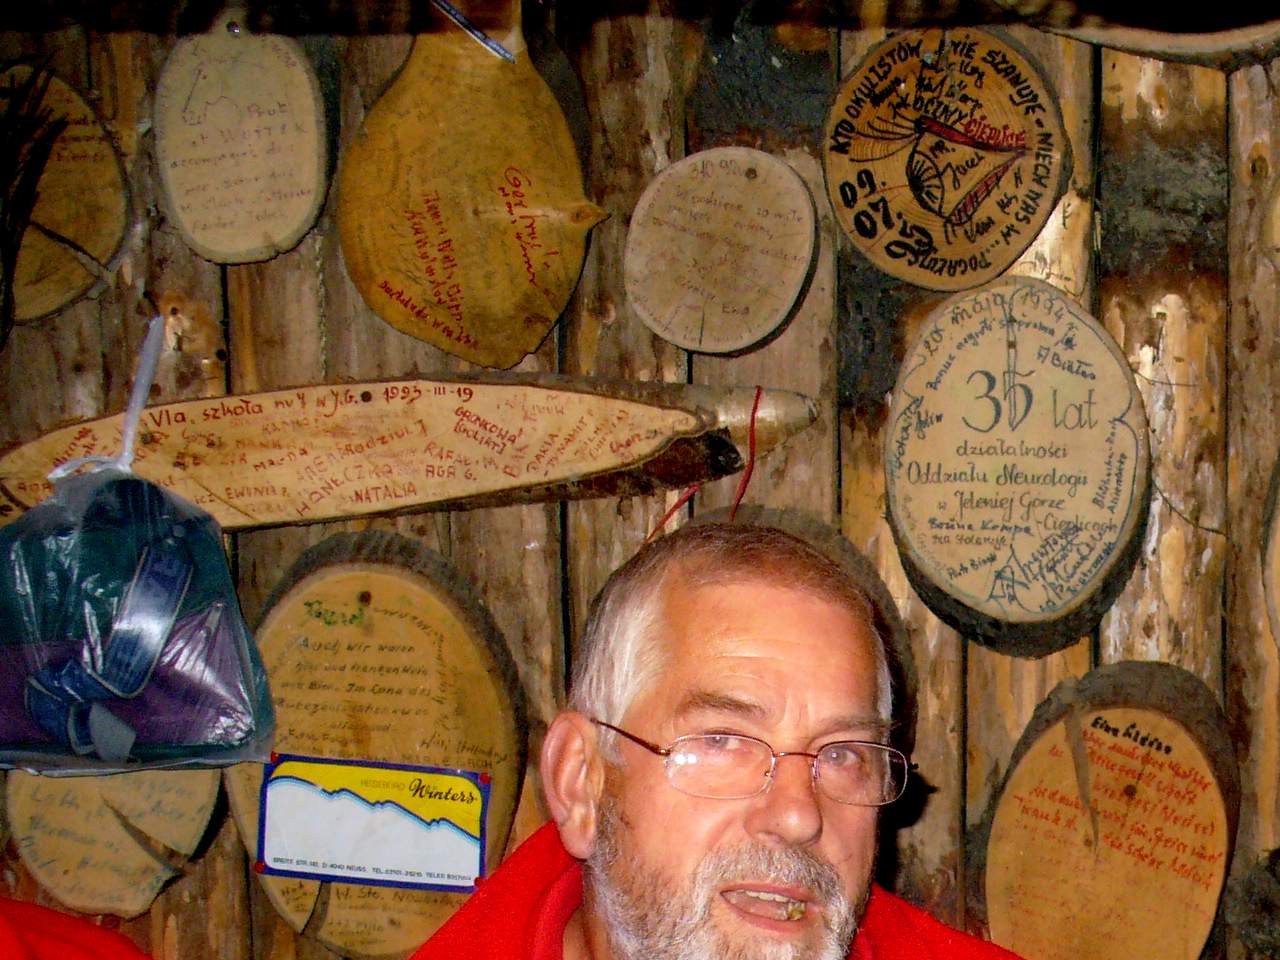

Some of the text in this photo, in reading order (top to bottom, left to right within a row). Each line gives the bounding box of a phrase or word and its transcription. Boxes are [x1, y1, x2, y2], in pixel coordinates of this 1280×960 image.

[829, 119, 857, 154] KTO
[981, 49, 1046, 115] SZANUJE
[961, 369, 1099, 432] 35 lat
[956, 441, 1068, 459] działalności
[354, 482, 418, 504] NATALIA
[908, 461, 1089, 498] Oddziału Neurologii
[409, 778, 478, 804] Winters
